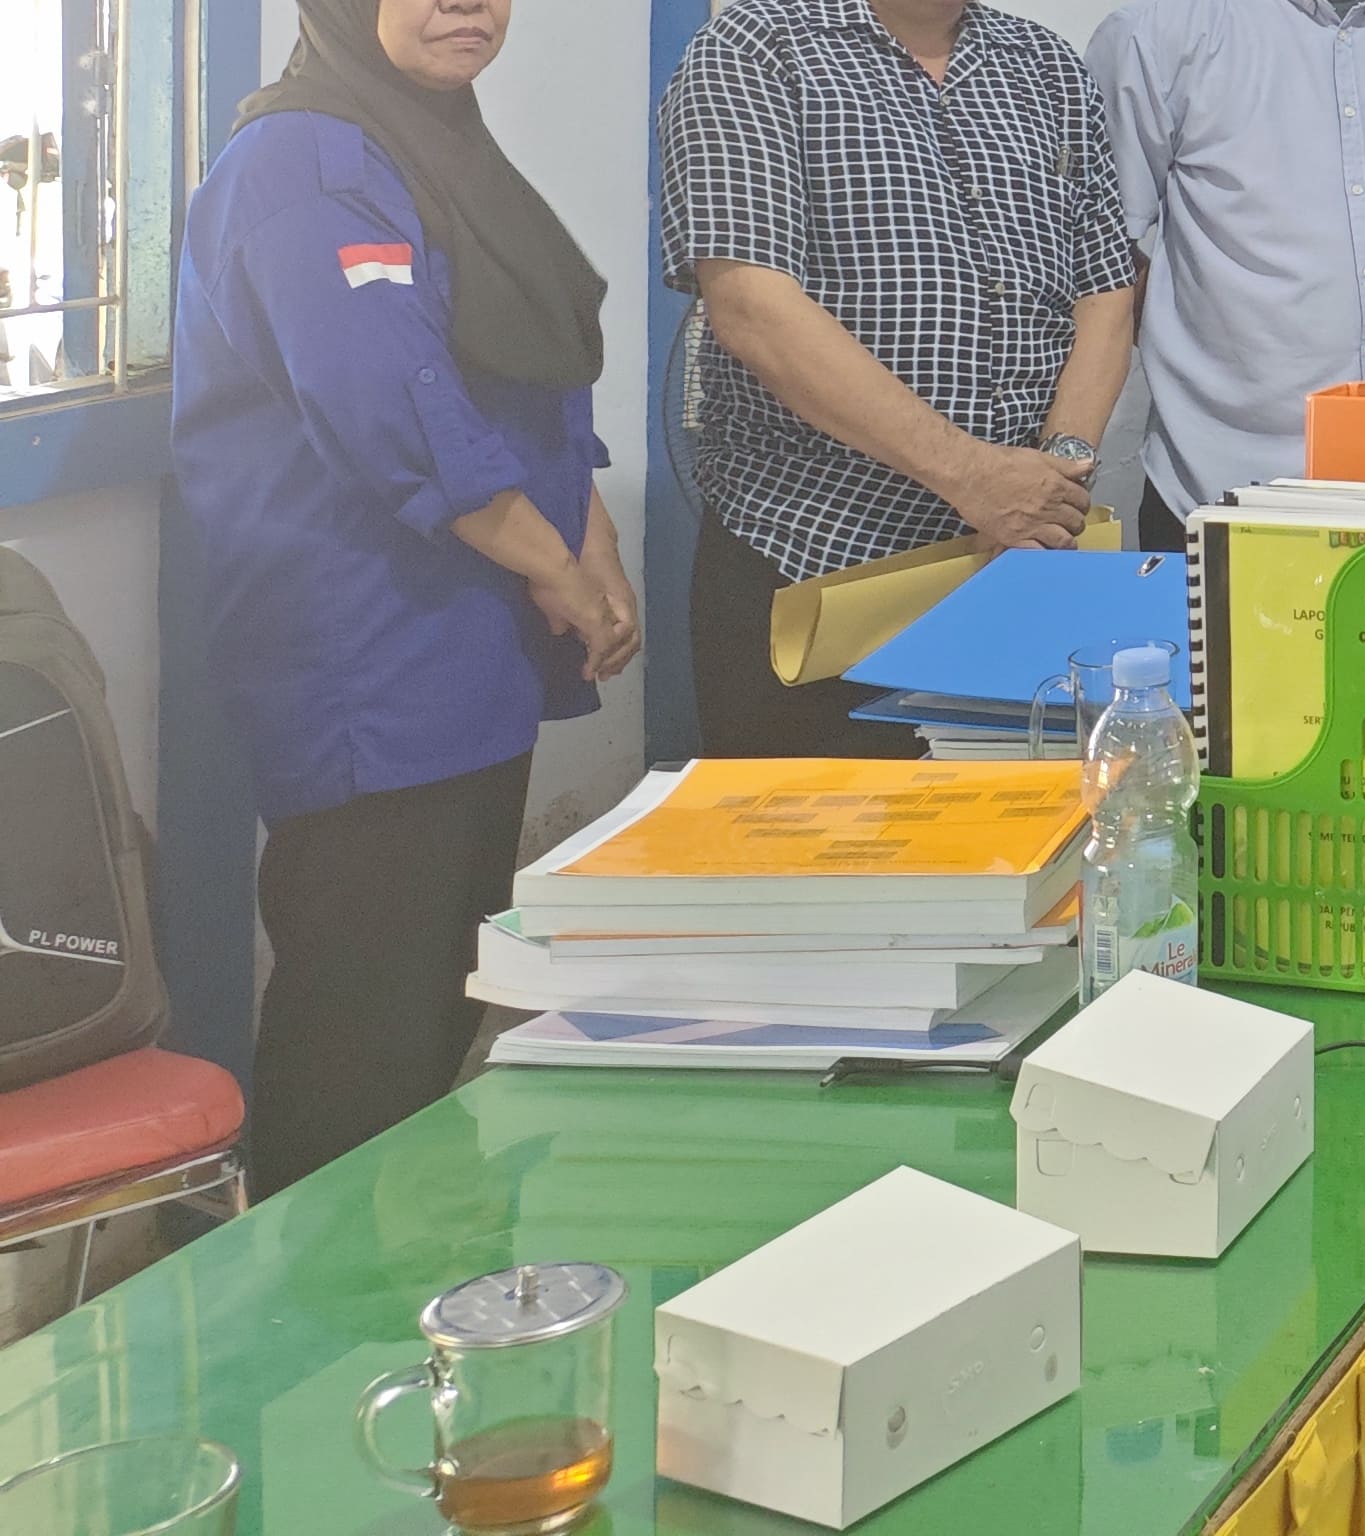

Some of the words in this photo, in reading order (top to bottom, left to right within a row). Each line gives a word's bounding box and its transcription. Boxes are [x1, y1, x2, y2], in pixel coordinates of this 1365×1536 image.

[28, 930, 51, 946] PL
[54, 933, 119, 955] POWER
[1168, 942, 1186, 961] Le
